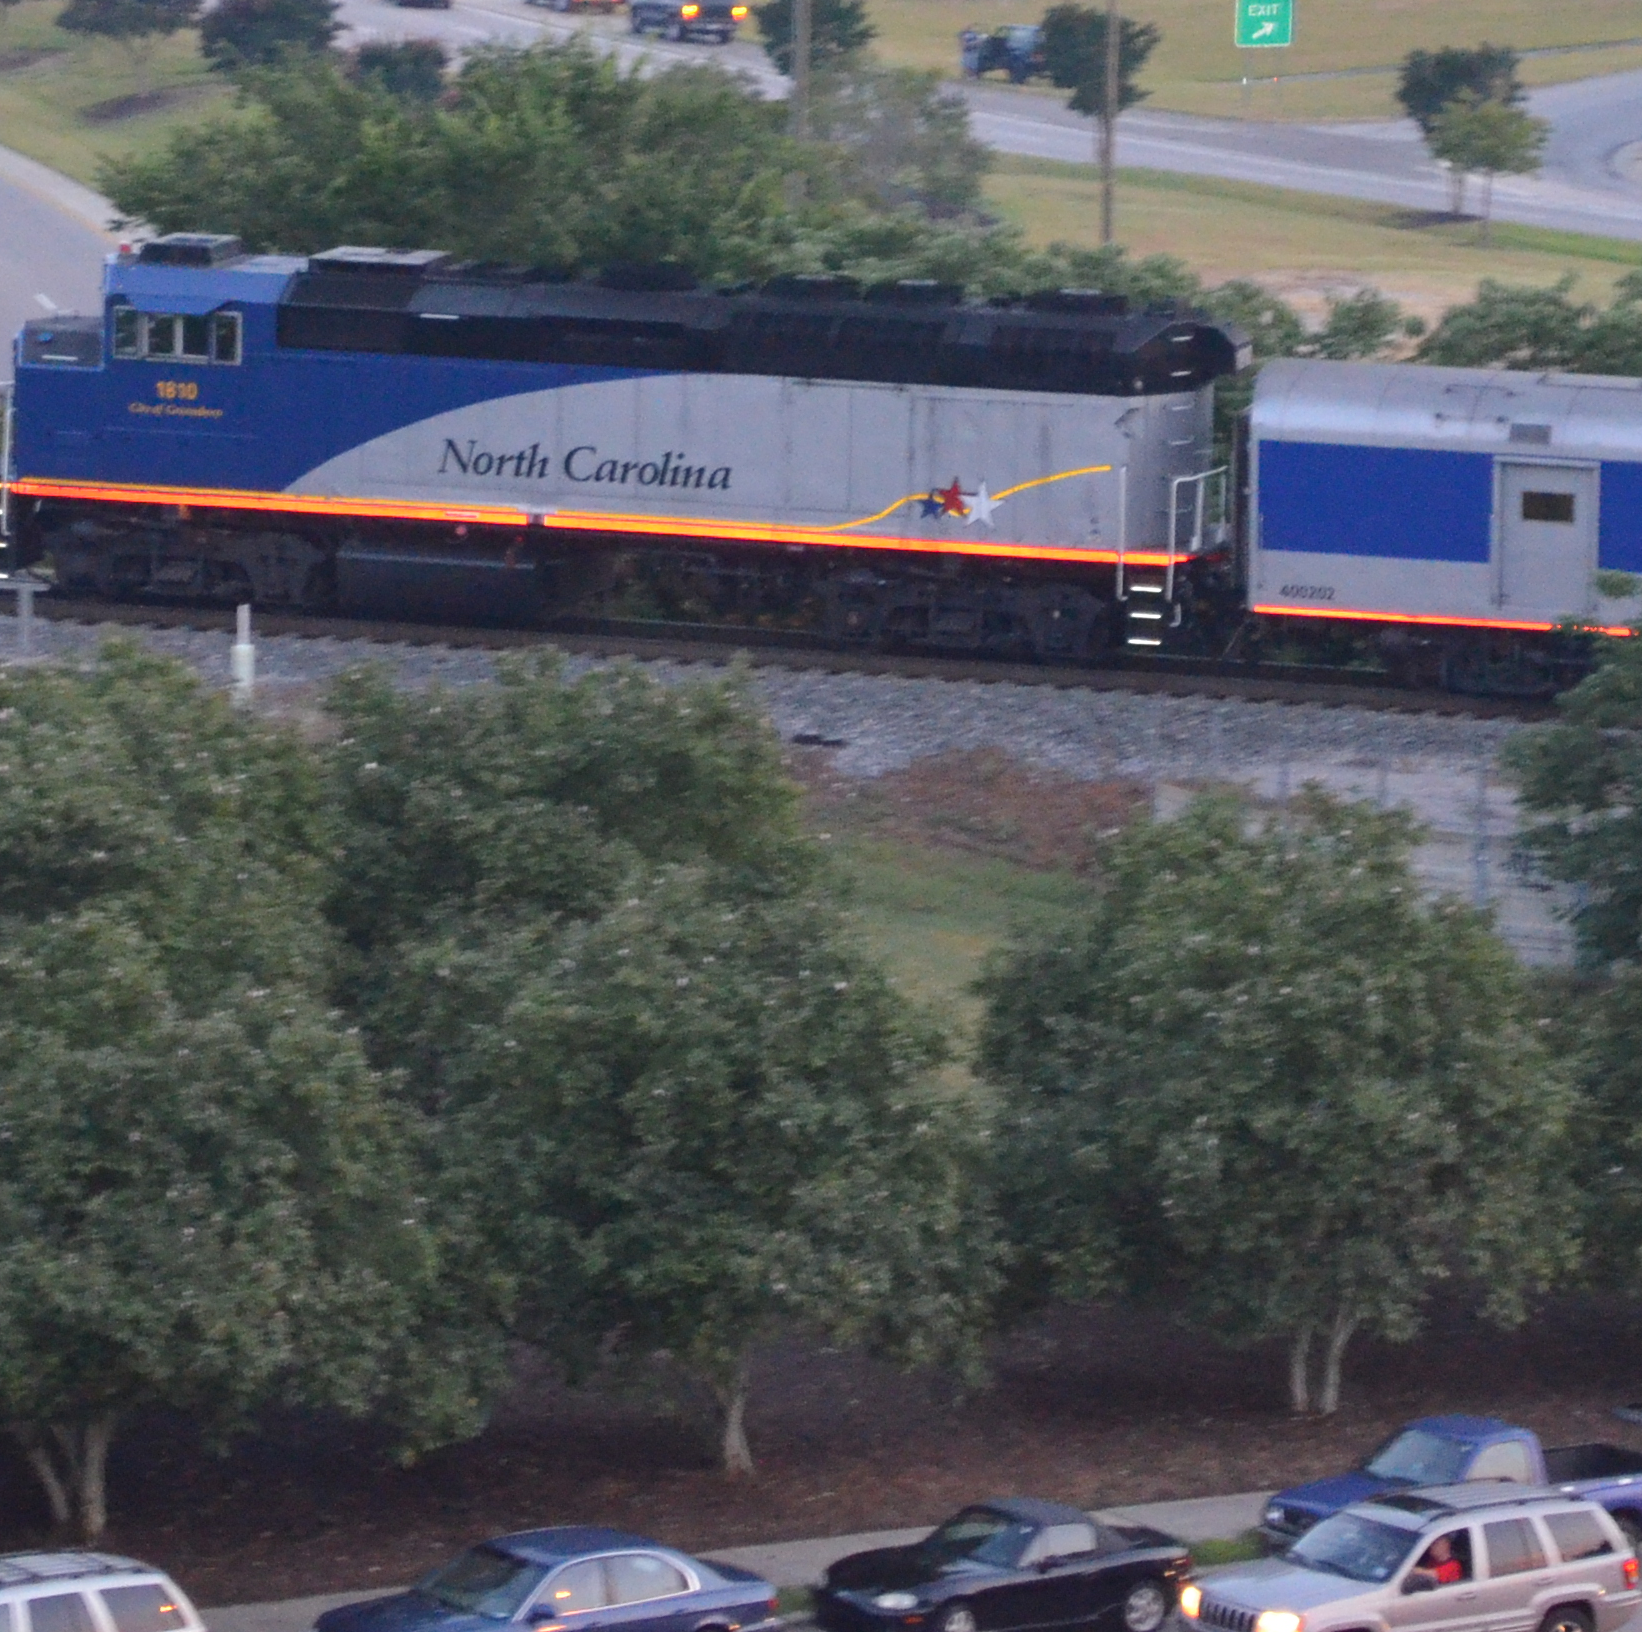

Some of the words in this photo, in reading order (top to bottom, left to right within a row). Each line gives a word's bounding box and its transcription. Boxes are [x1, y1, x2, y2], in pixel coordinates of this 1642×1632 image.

[1248, 3, 1280, 16] EXIT
[437, 438, 550, 479] North
[563, 446, 733, 490] Carolina
